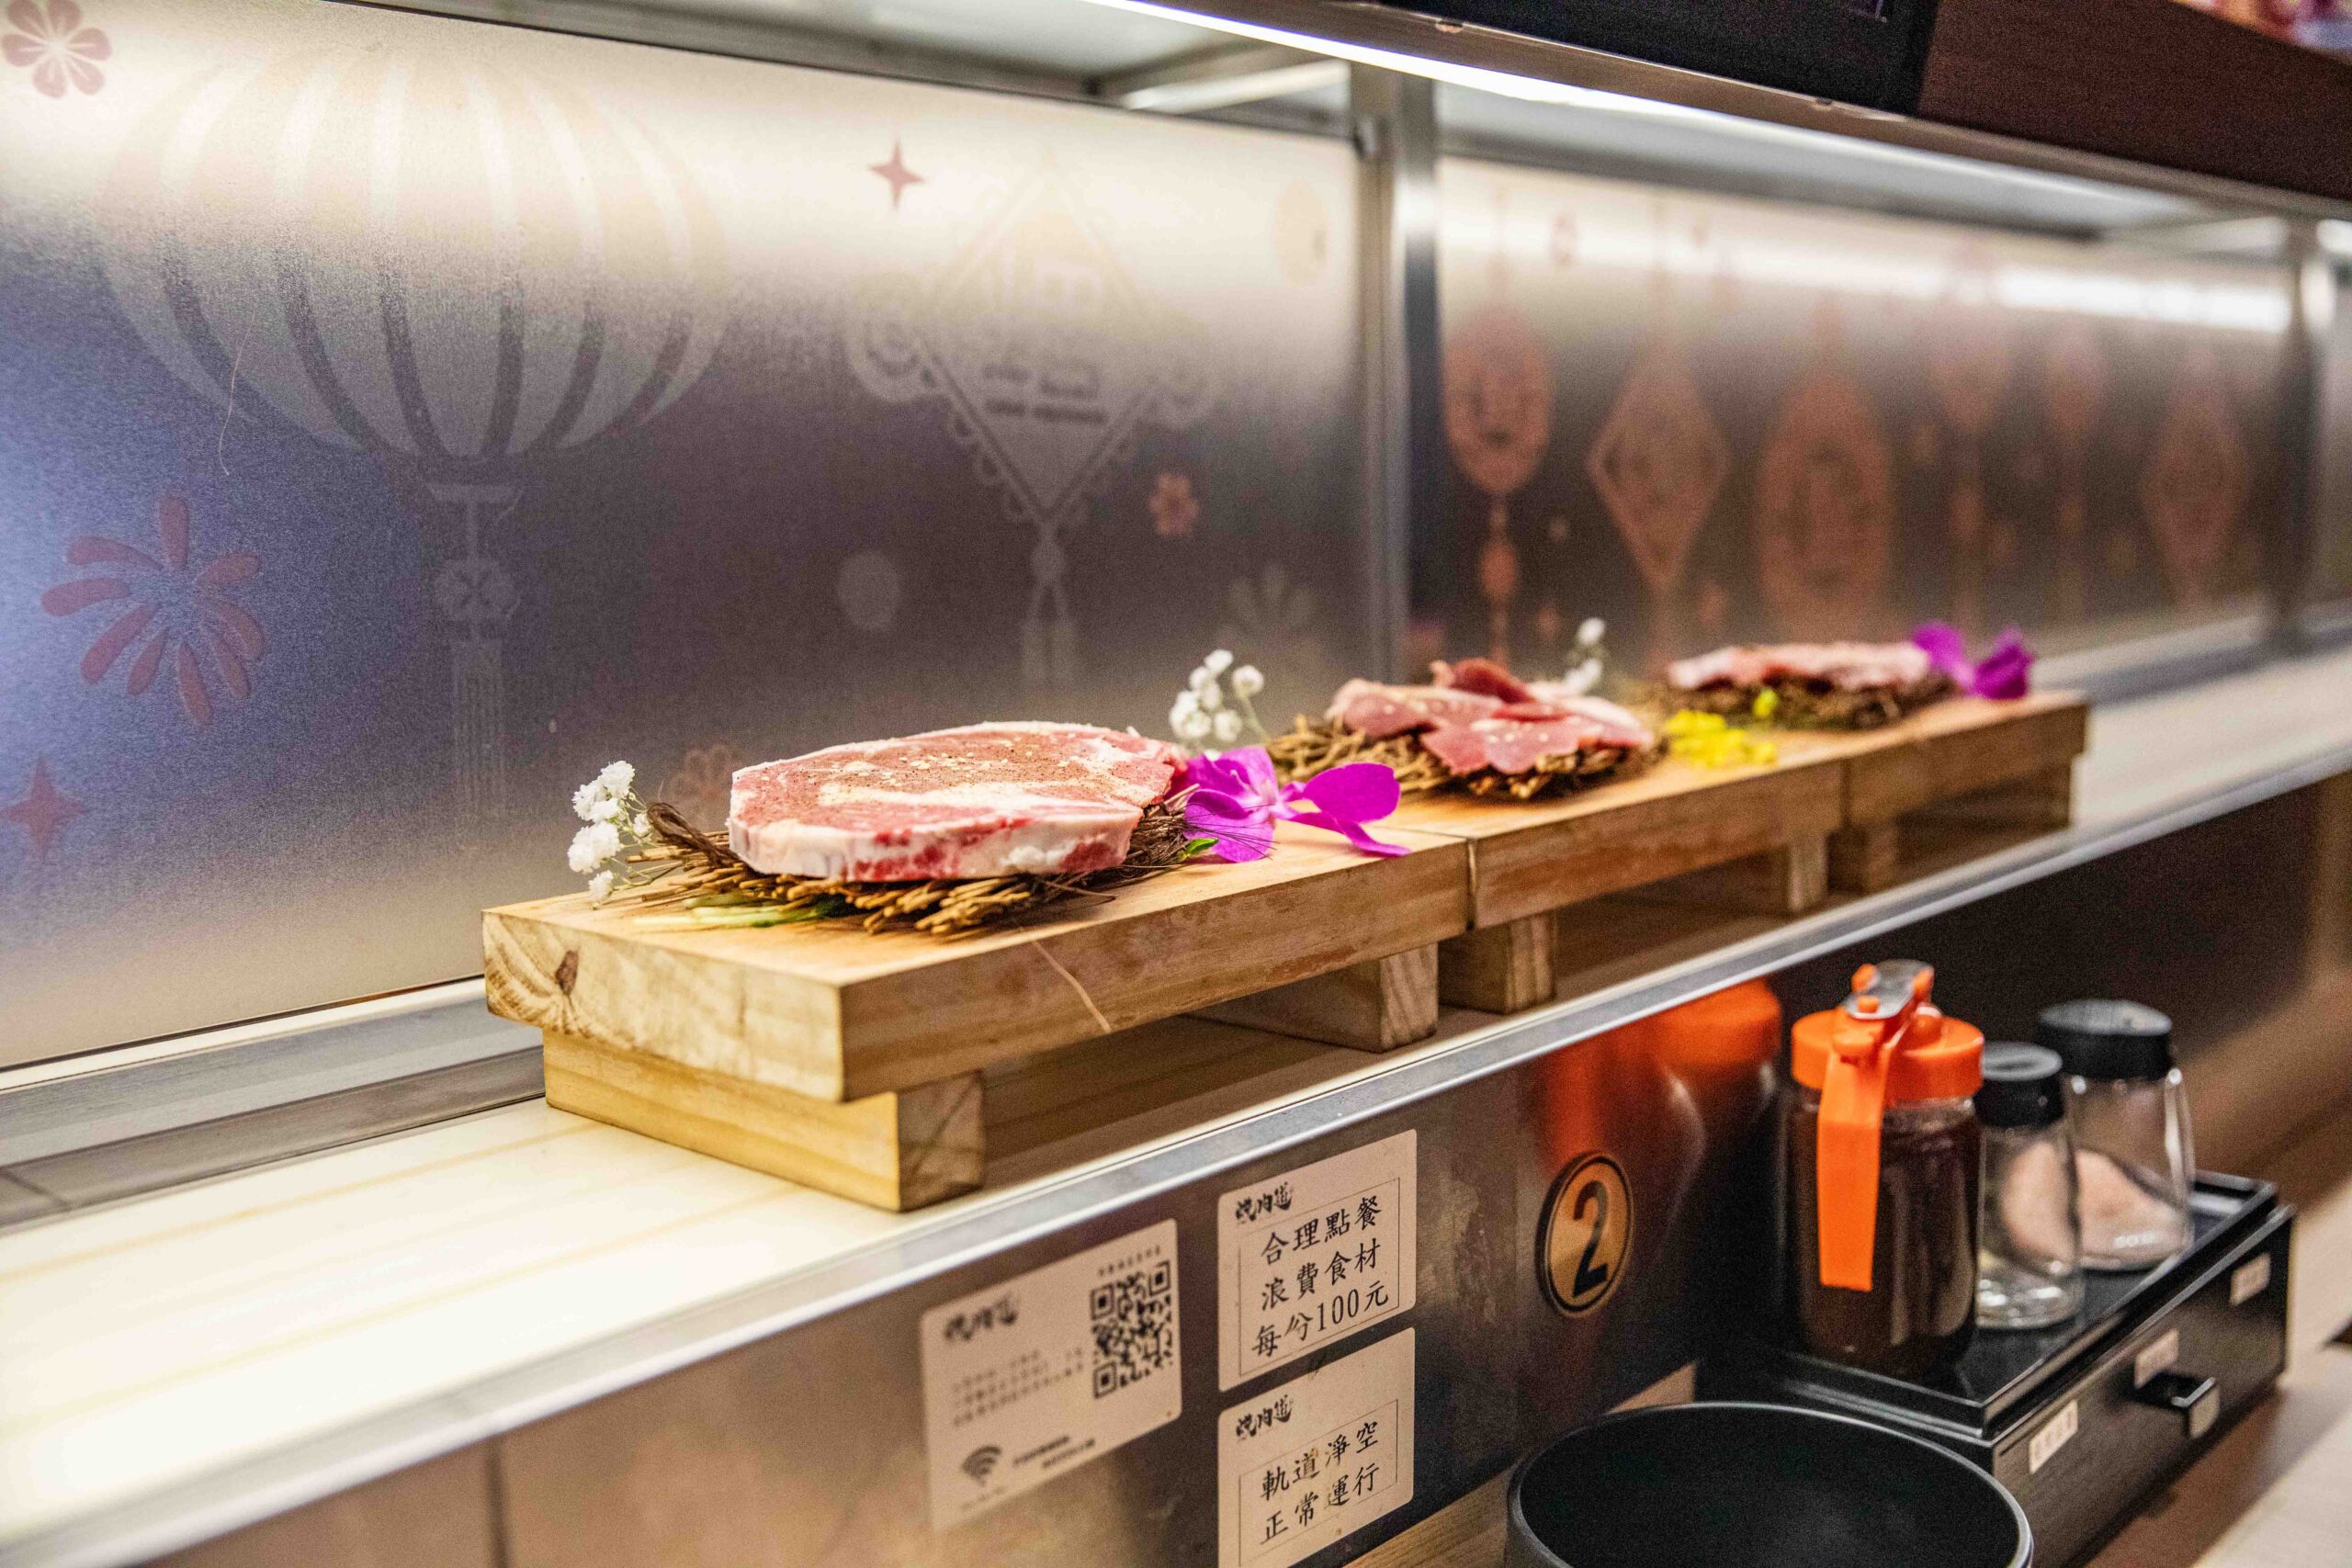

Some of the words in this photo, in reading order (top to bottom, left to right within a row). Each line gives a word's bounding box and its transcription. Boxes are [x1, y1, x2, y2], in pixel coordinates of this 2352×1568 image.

[1261, 1196, 1381, 1265] 合理點餐
[1573, 1179, 1609, 1298] 2
[1261, 1237, 1381, 1311] 浪費食材
[1252, 1280, 1389, 1358] 每份100元
[1261, 1421, 1378, 1502] 軌道淨空
[1261, 1462, 1380, 1545] 正常運行
